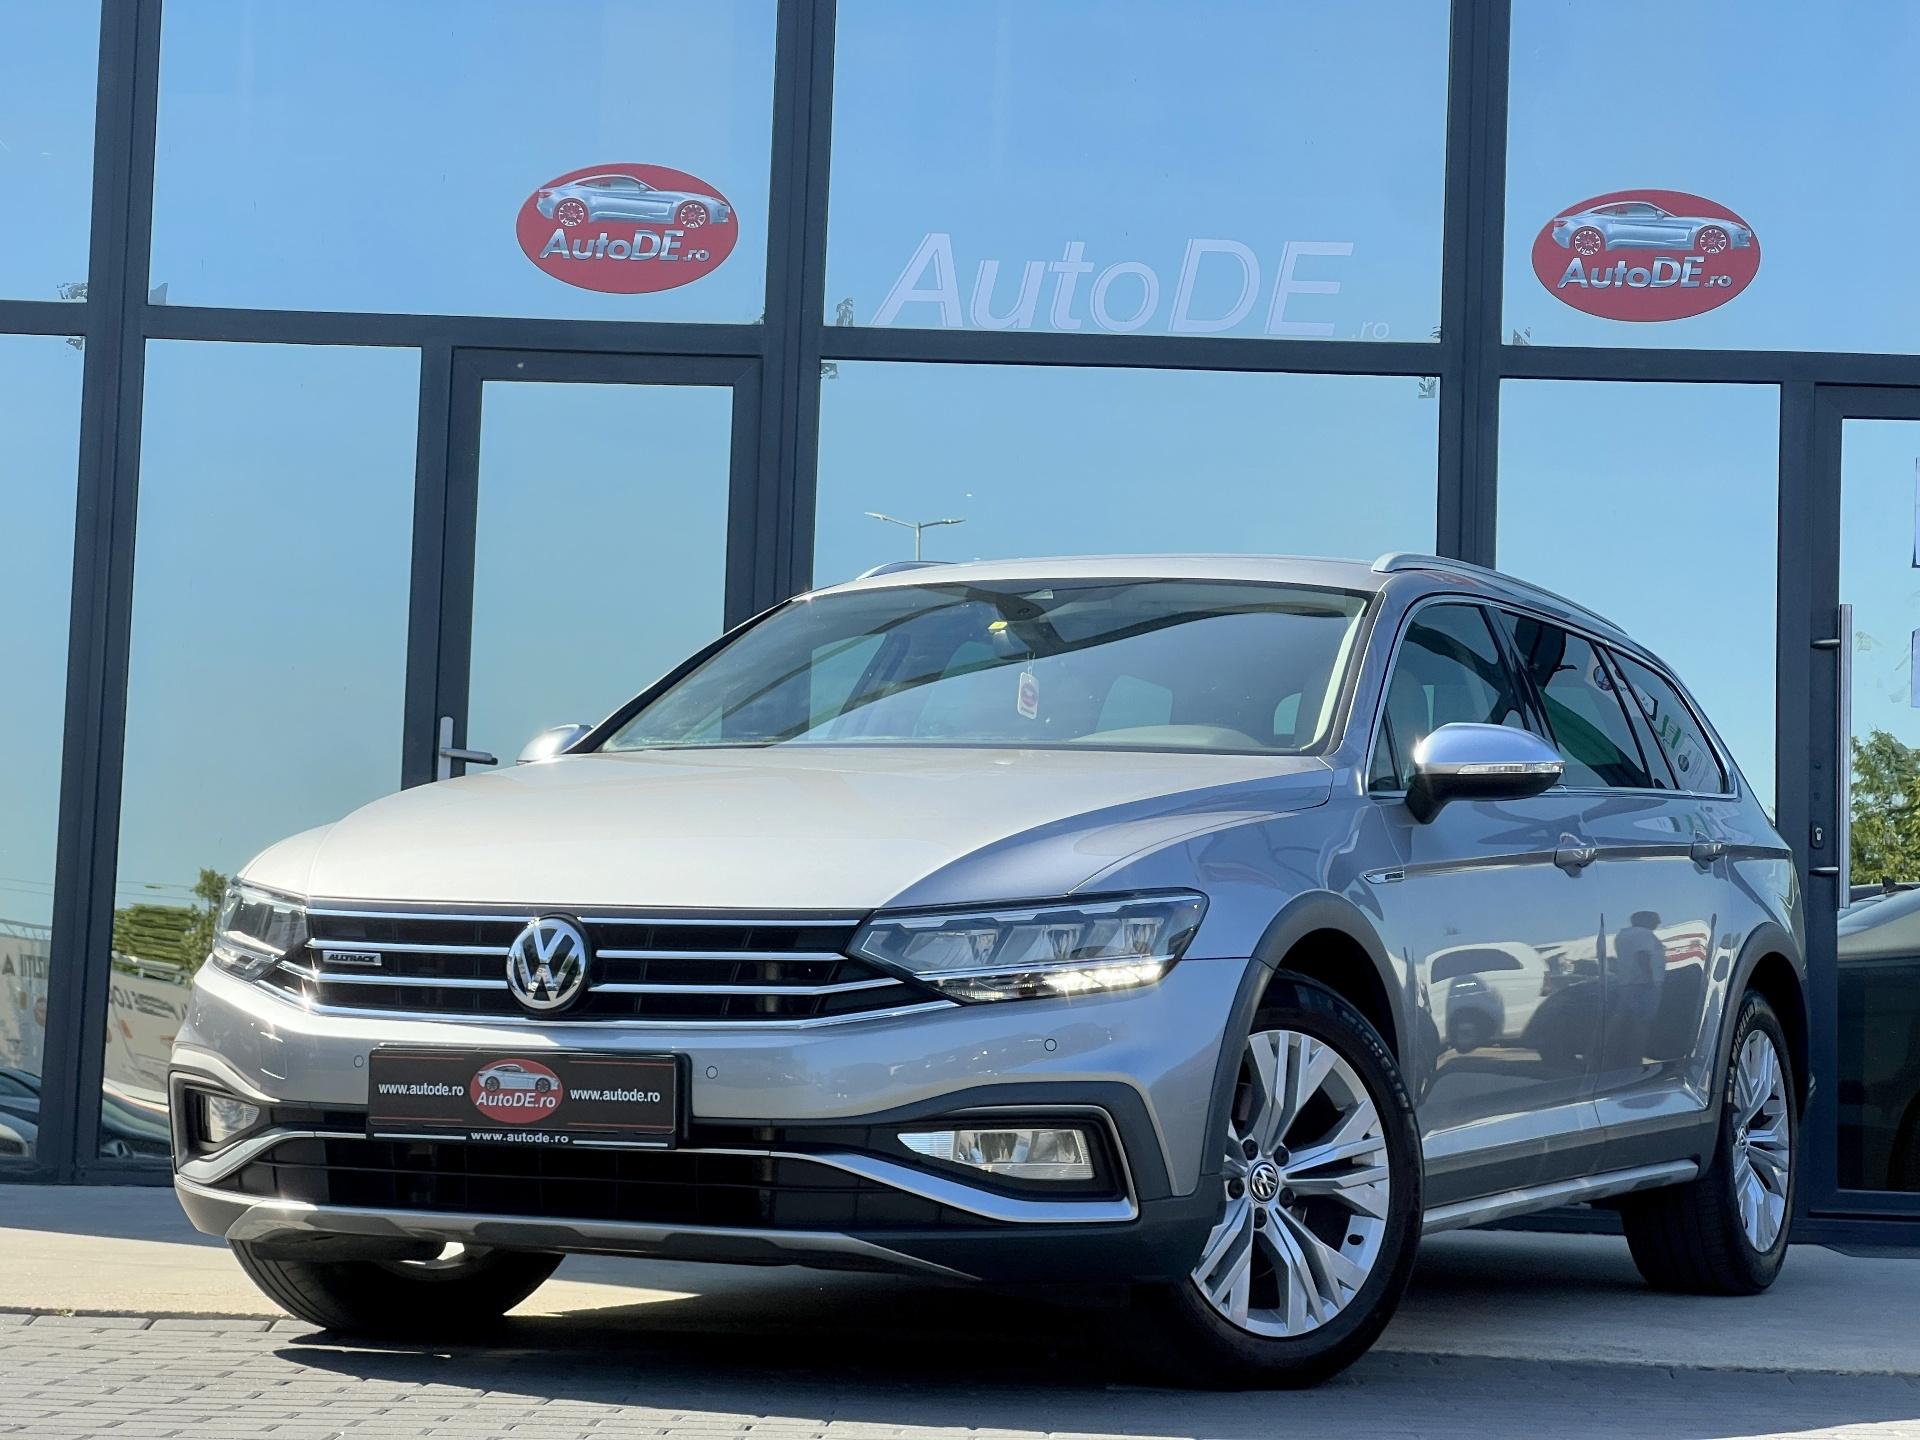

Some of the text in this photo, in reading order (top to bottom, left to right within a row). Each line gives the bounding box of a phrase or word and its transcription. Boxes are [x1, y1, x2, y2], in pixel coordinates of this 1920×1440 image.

[327, 953, 377, 963] ALLTRACK
[378, 1082, 465, 1097] www.autode.ro
[569, 1087, 661, 1103] www.autode.ro
[475, 1091, 557, 1108] AutoDE.ro
[470, 1130, 570, 1144] www.autode.ro
